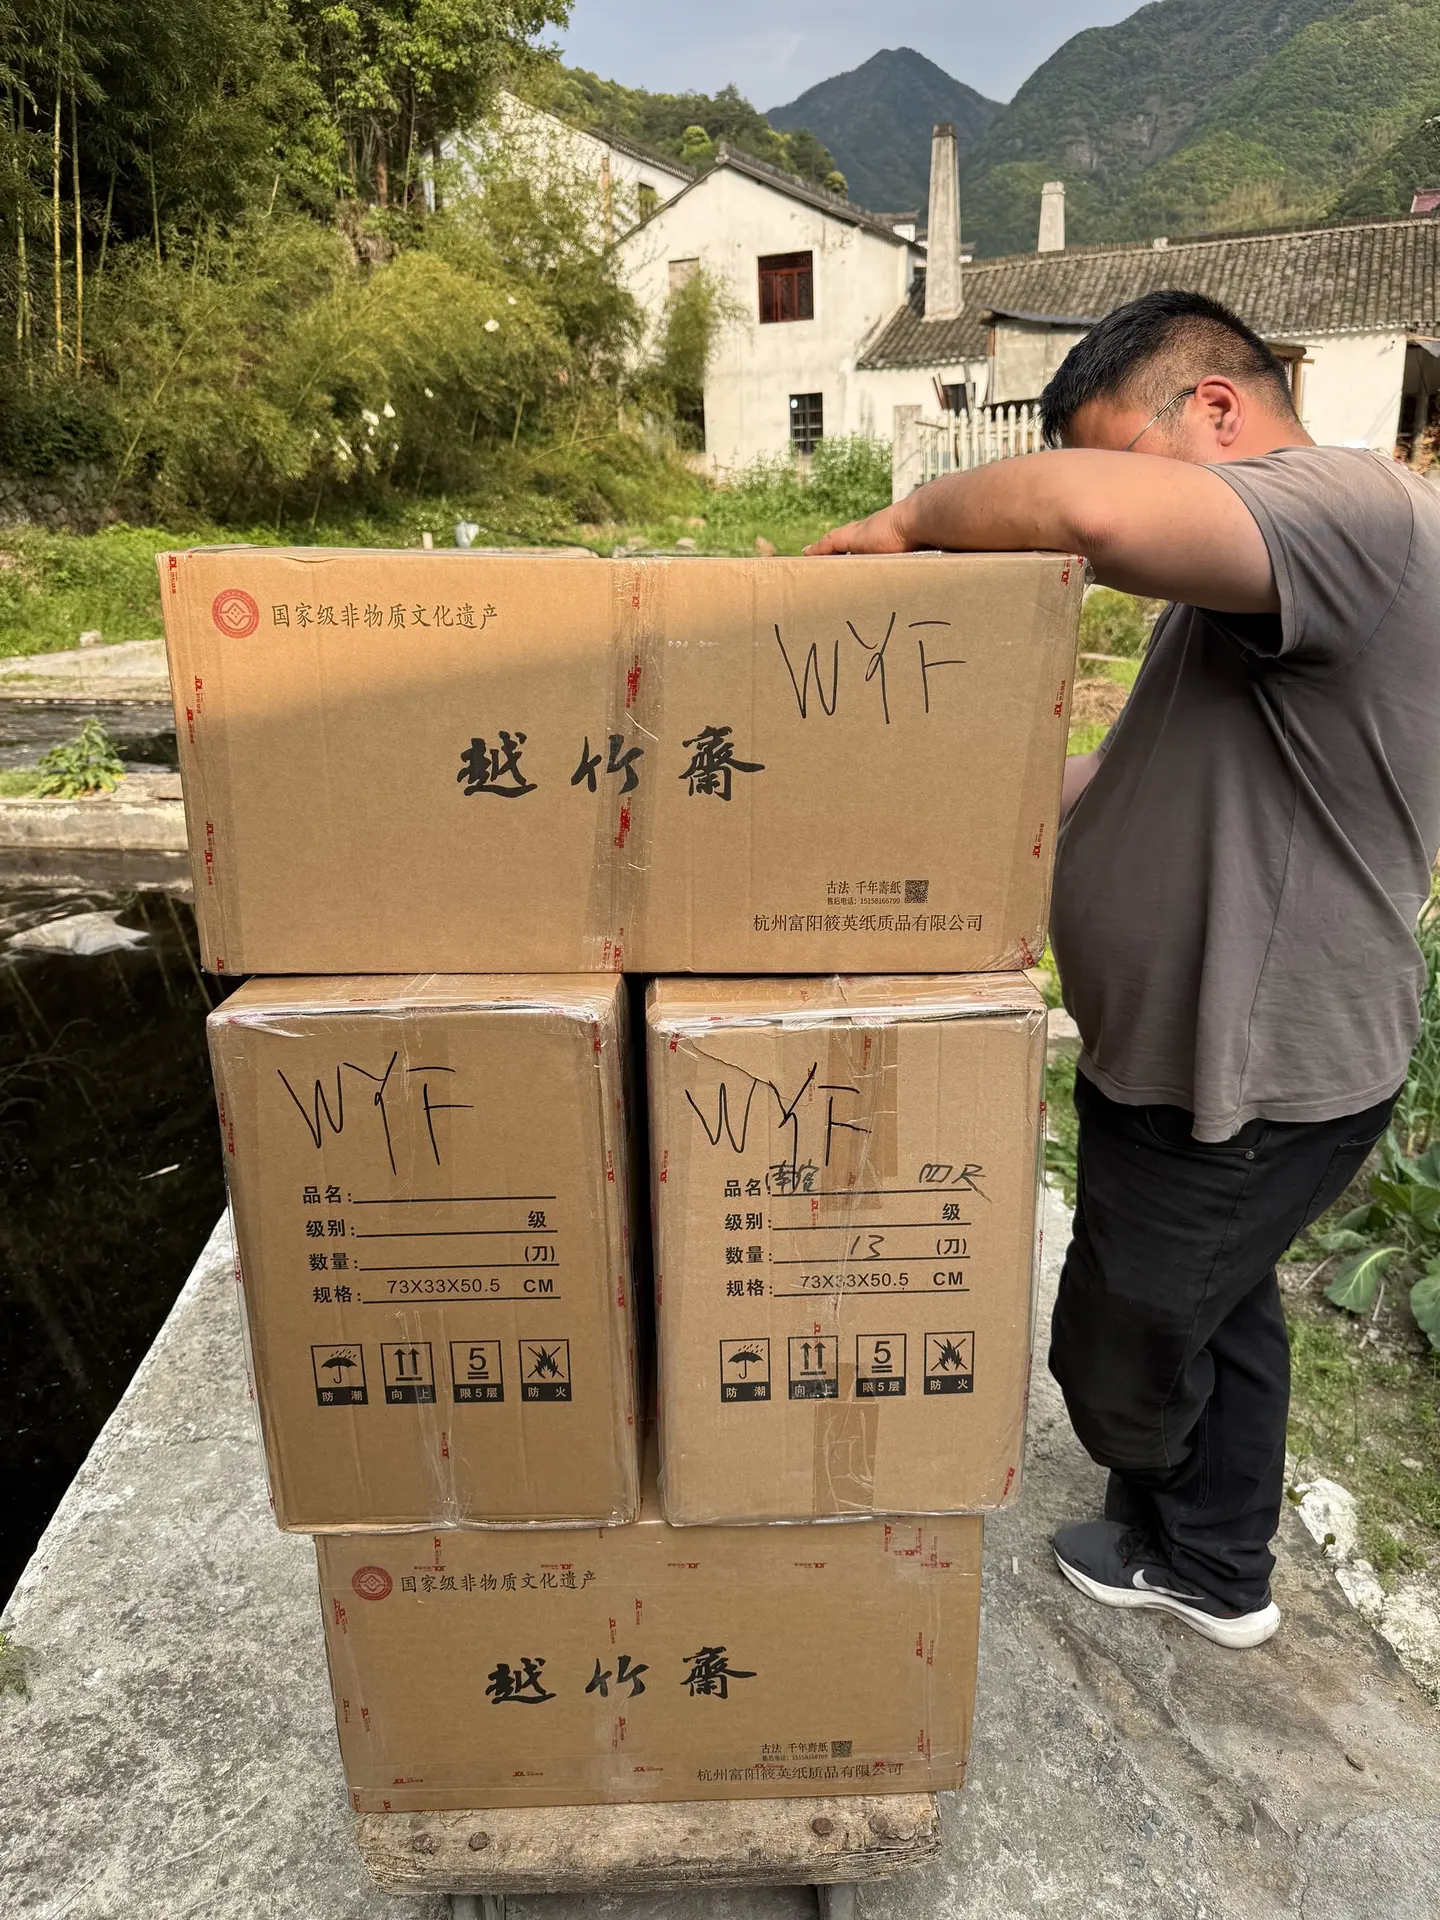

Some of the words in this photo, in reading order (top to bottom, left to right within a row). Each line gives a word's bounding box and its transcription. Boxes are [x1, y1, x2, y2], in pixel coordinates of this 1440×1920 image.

[271, 602, 498, 630] 国家级非物质文化遗产
[826, 880, 850, 895] 古法
[528, 1210, 547, 1228] 级
[942, 1203, 960, 1221] 级
[850, 1235, 885, 1260] 13
[387, 1278, 500, 1294] 73X33X50.5
[523, 1278, 554, 1293] CM
[932, 1271, 962, 1287] CM
[469, 1347, 487, 1371] 5
[873, 1340, 891, 1364] 5
[400, 1569, 597, 1593] 国家级非物质文化遗产
[760, 1743, 782, 1753] 古法
